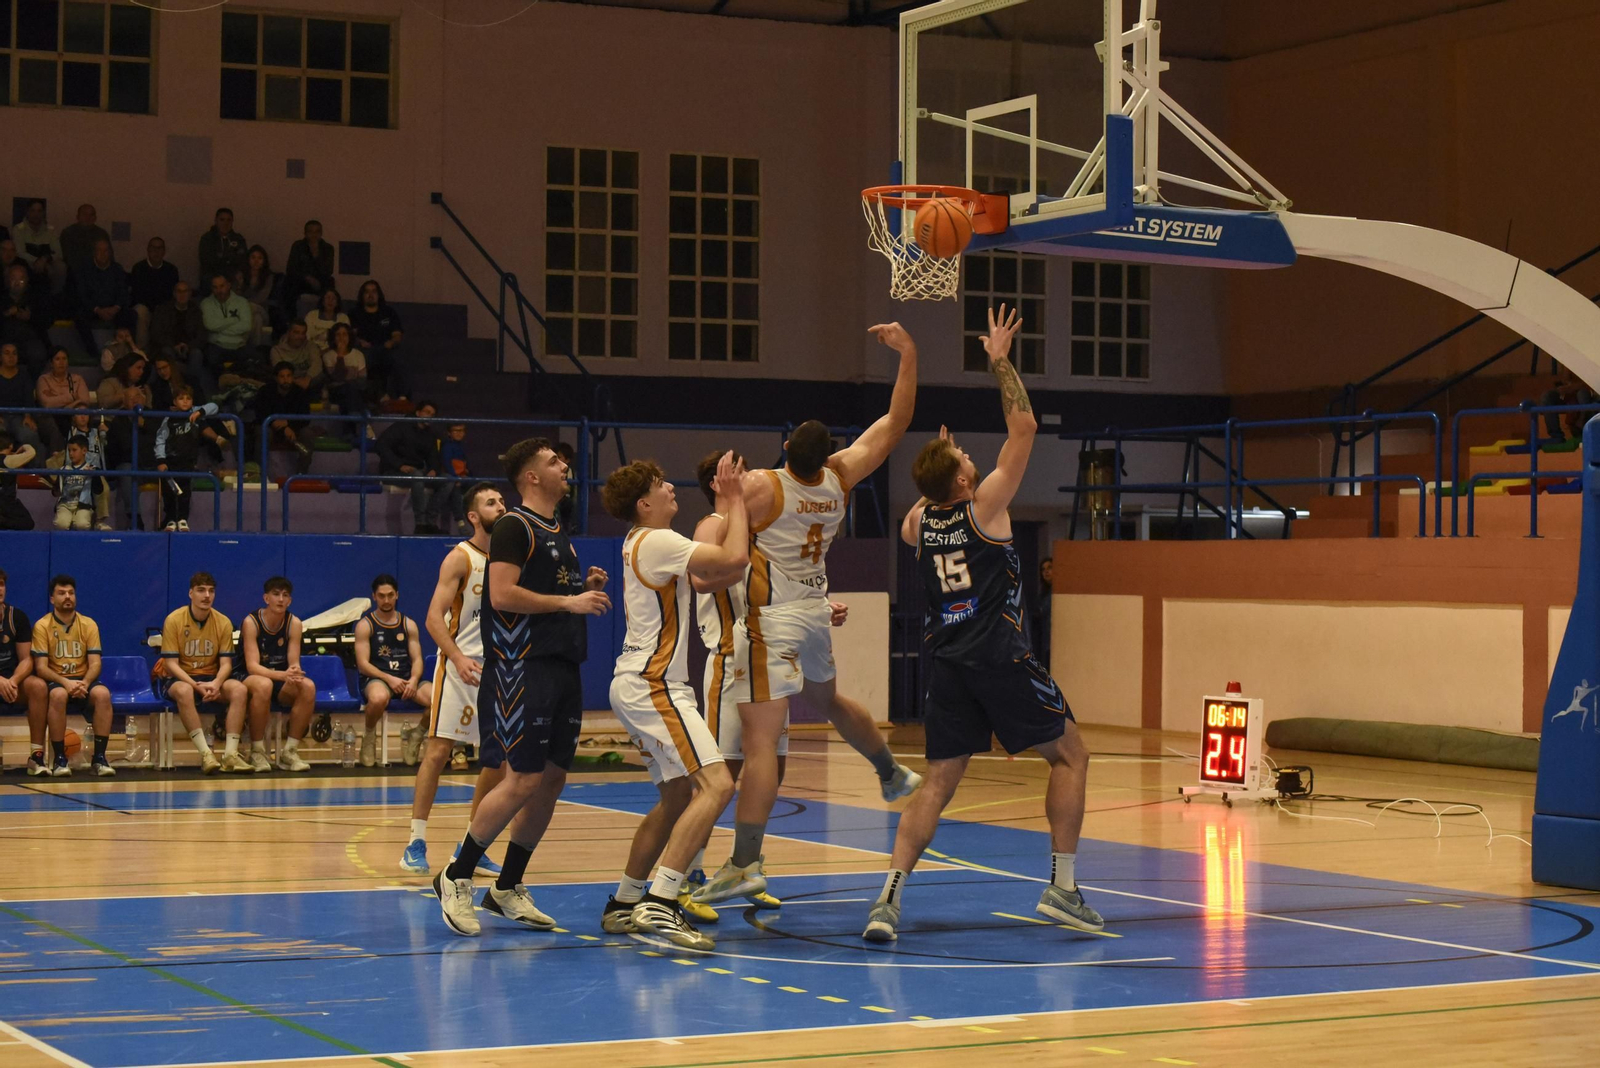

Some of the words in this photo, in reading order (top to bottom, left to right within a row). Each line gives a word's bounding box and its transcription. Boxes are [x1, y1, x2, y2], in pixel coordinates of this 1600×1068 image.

[800, 523, 825, 565] 4
[933, 550, 972, 593] 15
[55, 640, 83, 659] ULB
[184, 639, 214, 657] ULB
[388, 660, 400, 671] 12
[460, 705, 474, 726] 8
[1208, 704, 1246, 728] 06:14
[1205, 732, 1245, 777] 2.4
